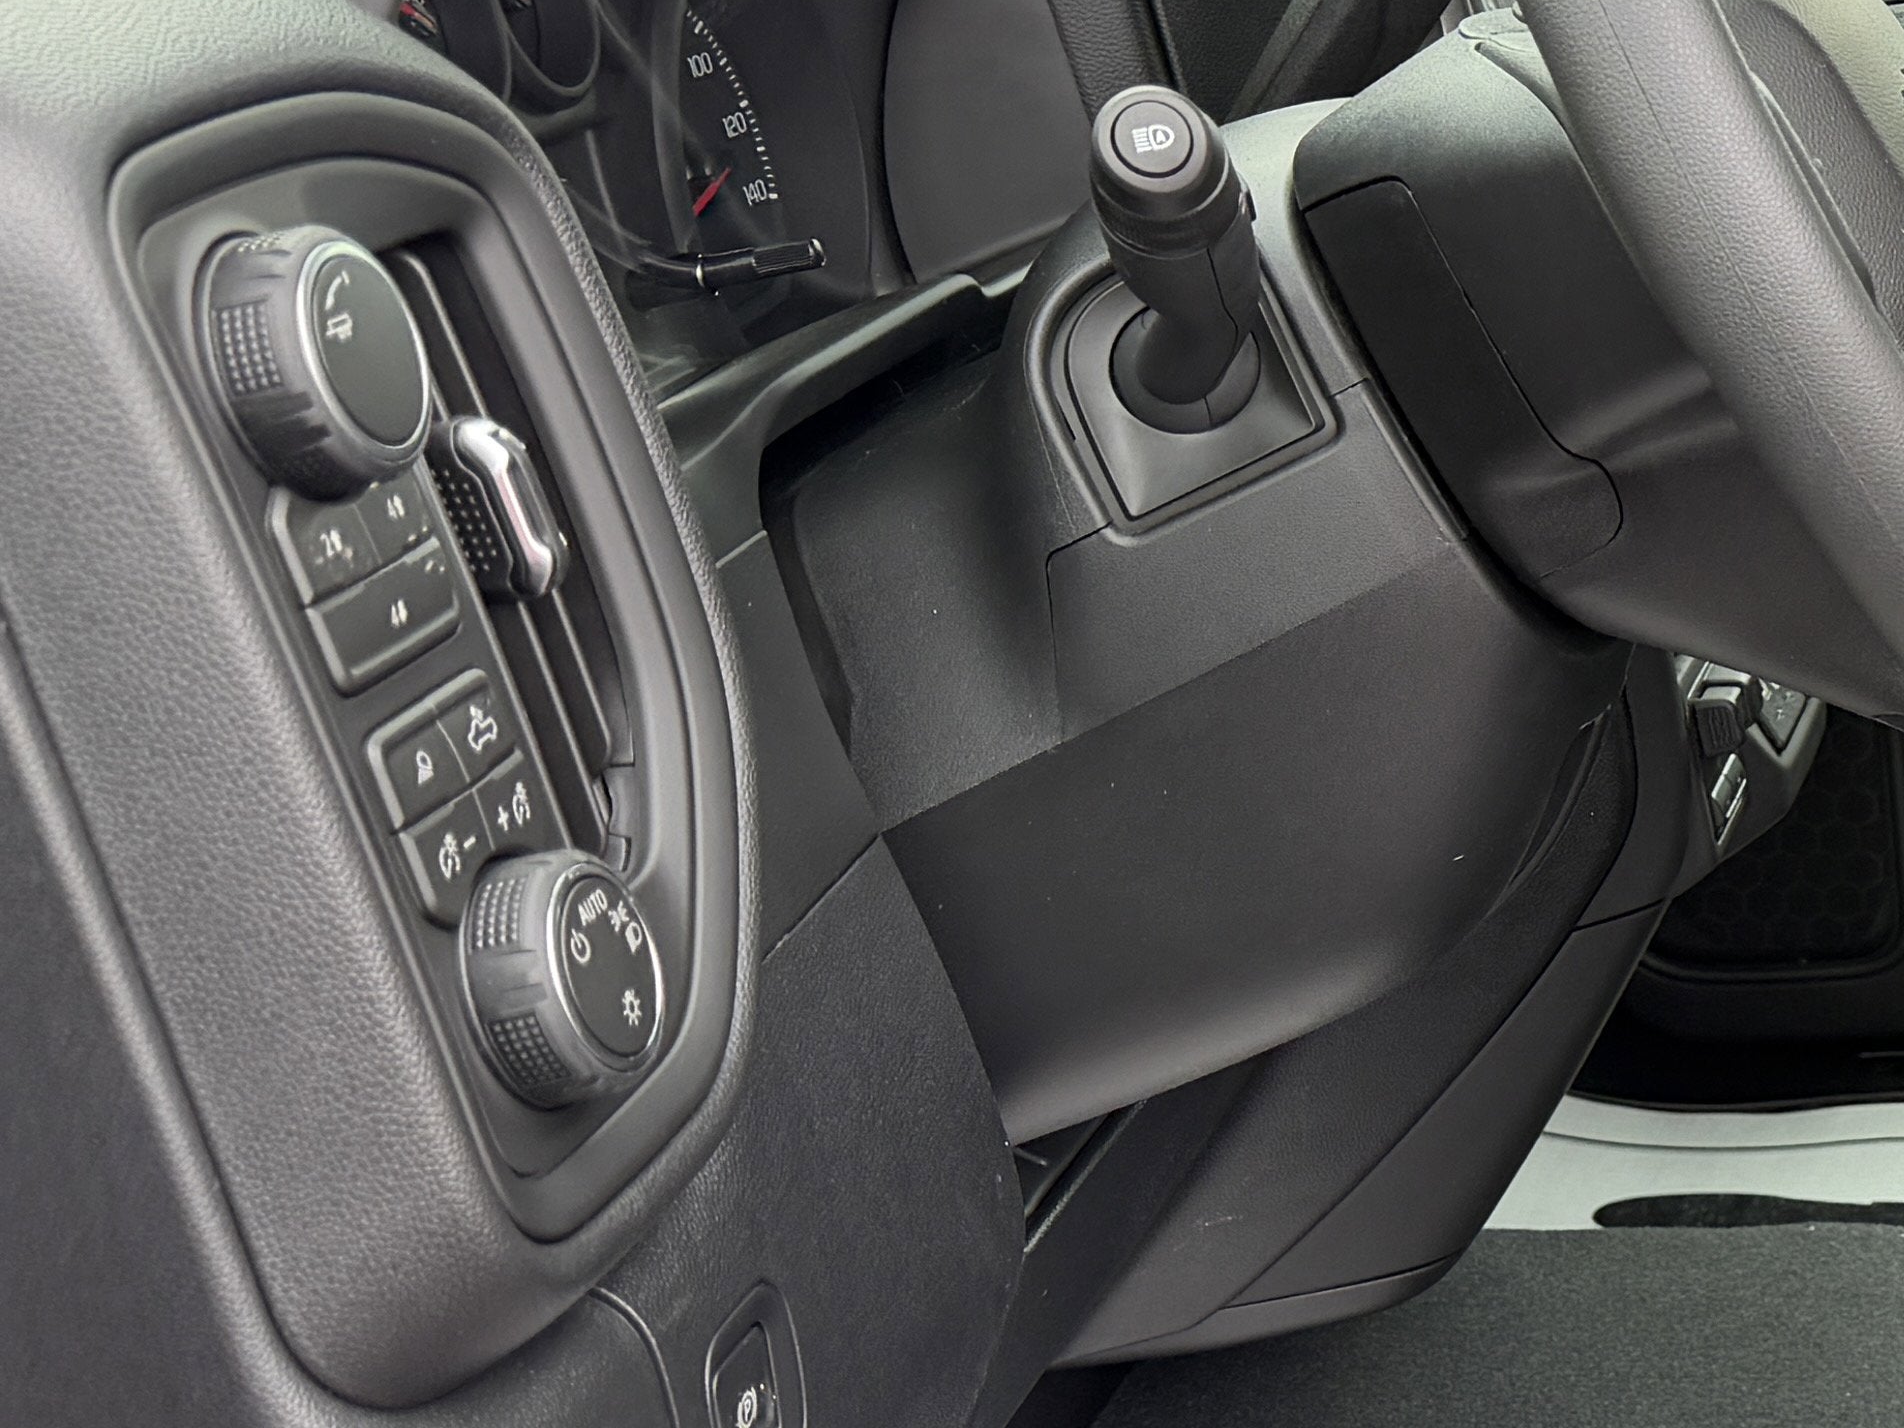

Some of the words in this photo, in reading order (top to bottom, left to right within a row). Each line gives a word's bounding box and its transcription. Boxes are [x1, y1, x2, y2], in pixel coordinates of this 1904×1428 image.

[687, 52, 713, 78] 100
[722, 112, 747, 138] 120
[743, 179, 768, 206] 140
[577, 888, 608, 926] AUTO
